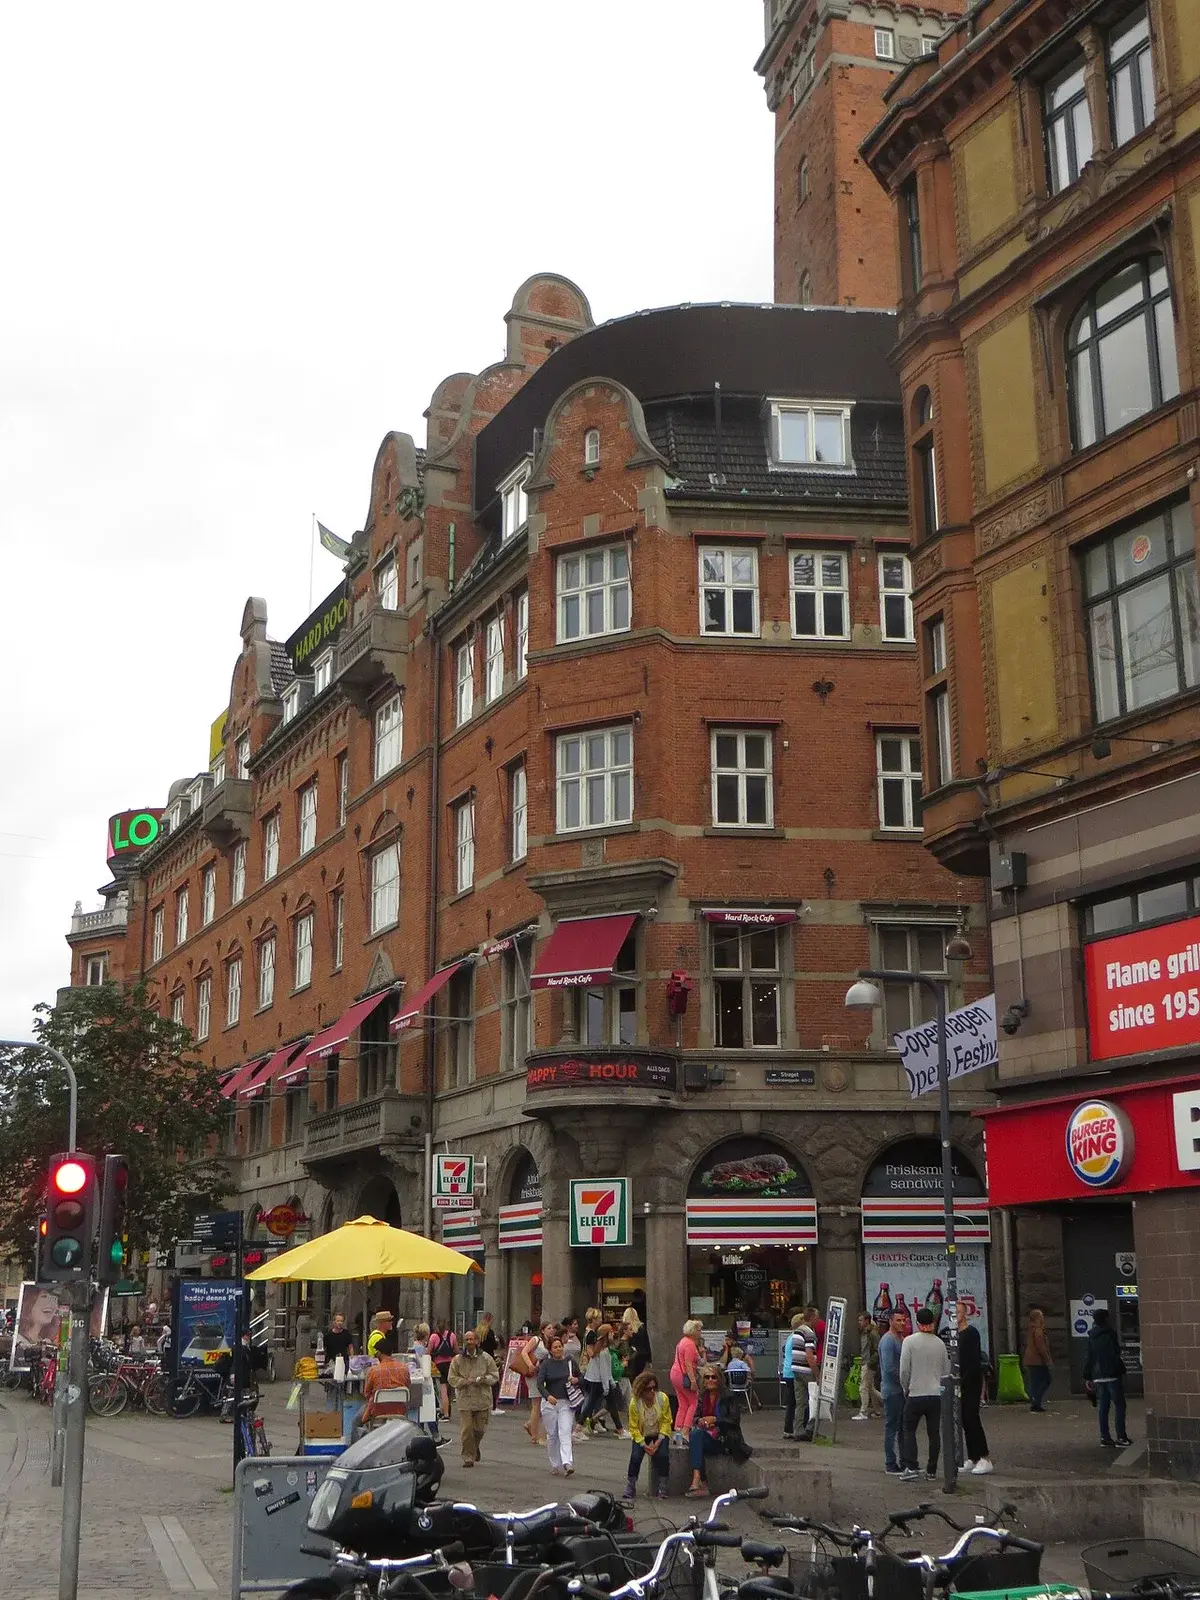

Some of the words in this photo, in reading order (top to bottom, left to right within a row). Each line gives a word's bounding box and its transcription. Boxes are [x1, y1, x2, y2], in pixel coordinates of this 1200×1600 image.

[296, 622, 321, 666] HARD
[114, 813, 164, 849] LO
[742, 914, 759, 923] Rock
[759, 914, 775, 923] Cafe
[547, 978, 563, 986] Hard
[563, 976, 578, 985] Rock
[578, 974, 593, 984] Cafe
[1107, 959, 1161, 990] Flame
[1109, 1003, 1155, 1032] since
[528, 1066, 557, 1083] HAPPY
[590, 1065, 638, 1079] HOUR
[1072, 1118, 1116, 1144] BURGER
[1073, 1133, 1117, 1165] KING
[885, 1165, 960, 1175] Frisksmut
[871, 1253, 908, 1261] GRATIS
[909, 1253, 960, 1261] Coca-Coa
